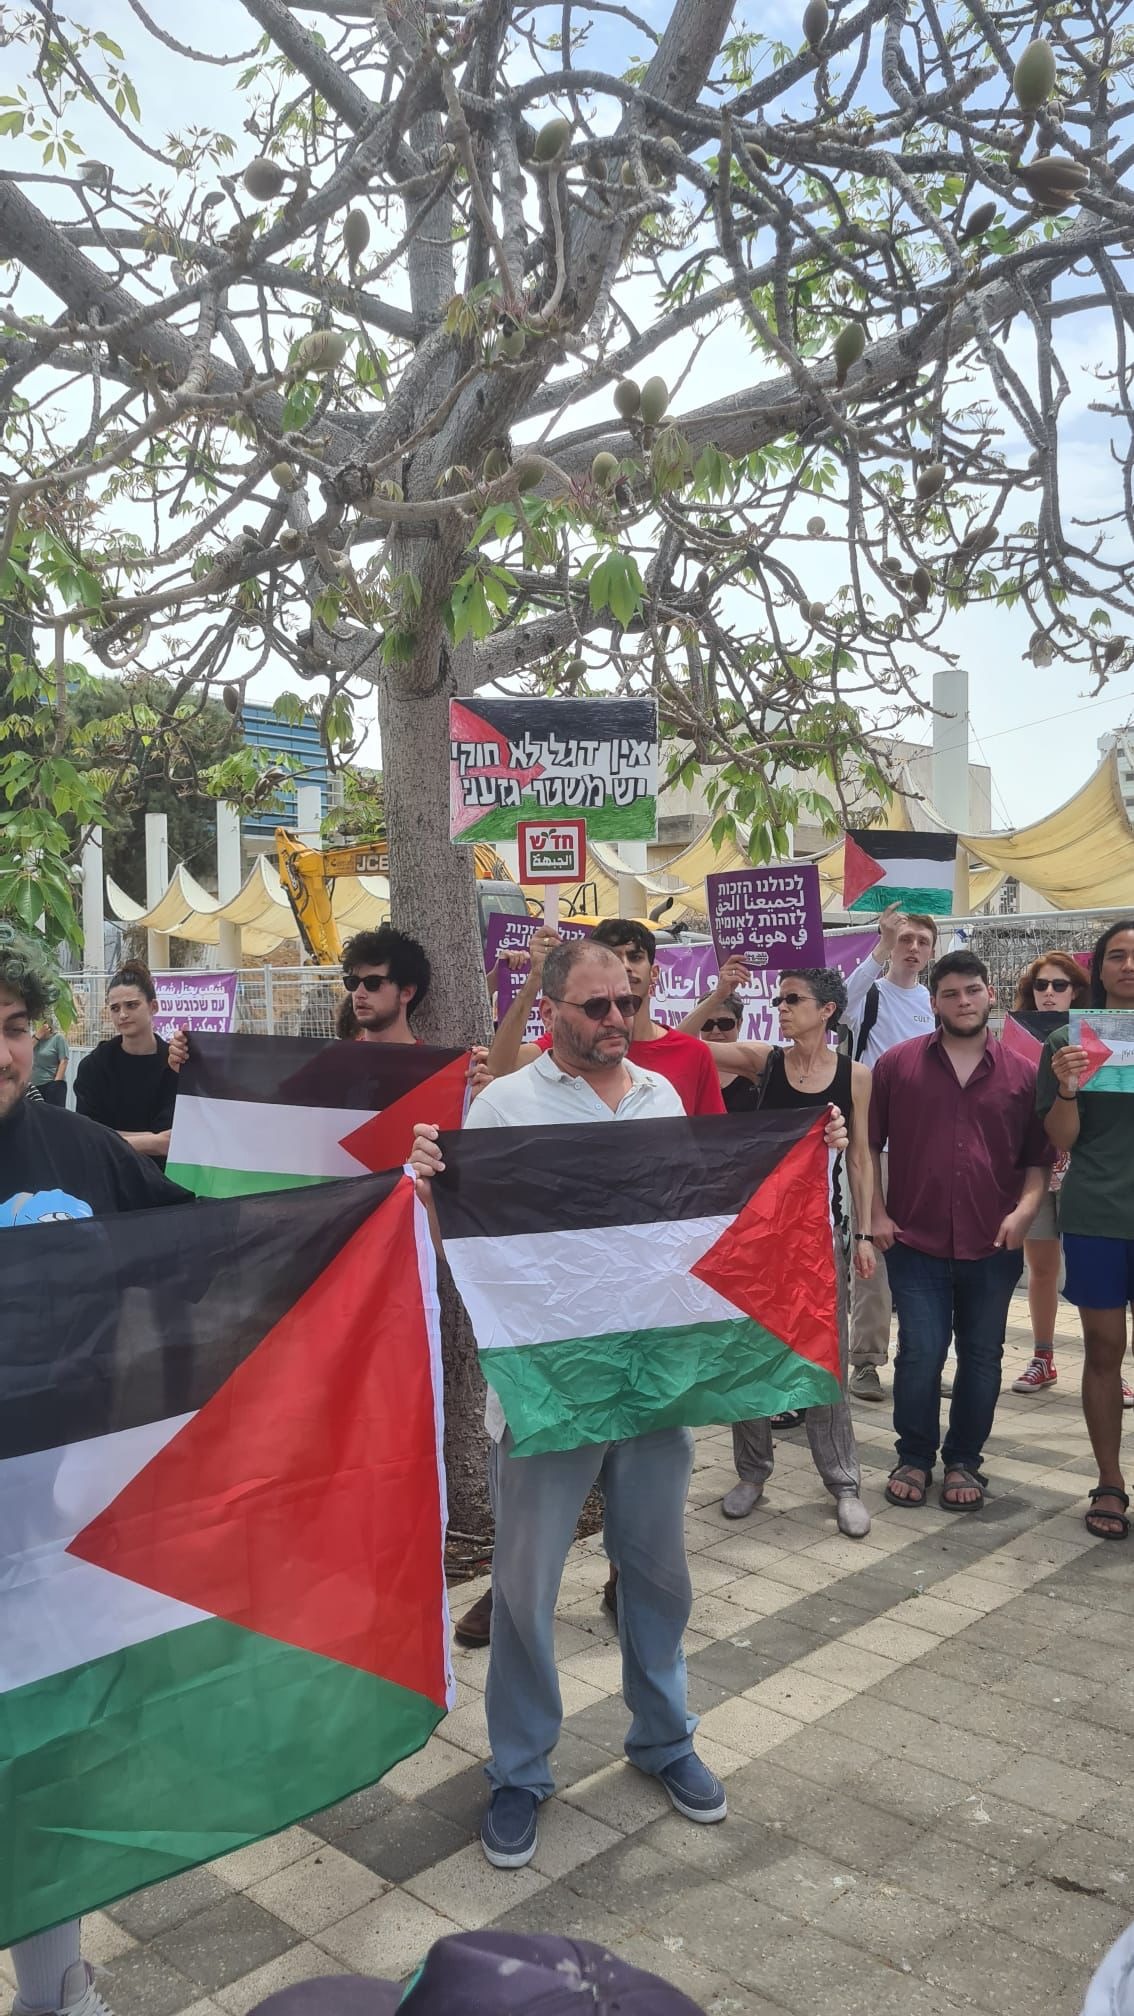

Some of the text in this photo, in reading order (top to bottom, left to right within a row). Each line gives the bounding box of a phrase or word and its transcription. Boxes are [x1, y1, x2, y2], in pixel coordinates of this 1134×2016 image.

[451, 731, 650, 777] אין דגל לא חוקי
[461, 774, 647, 808] יש משטר גזעני
[532, 853, 572, 869] الجبهة
[718, 874, 804, 896] לכולנו הזכות
[716, 890, 805, 916] لجميعنا الحق
[715, 909, 806, 930] לזהות לאומית
[718, 925, 808, 950] في هوية قومية
[160, 999, 225, 1012] עם שכובש עם
[747, 1005, 773, 1041] לא
